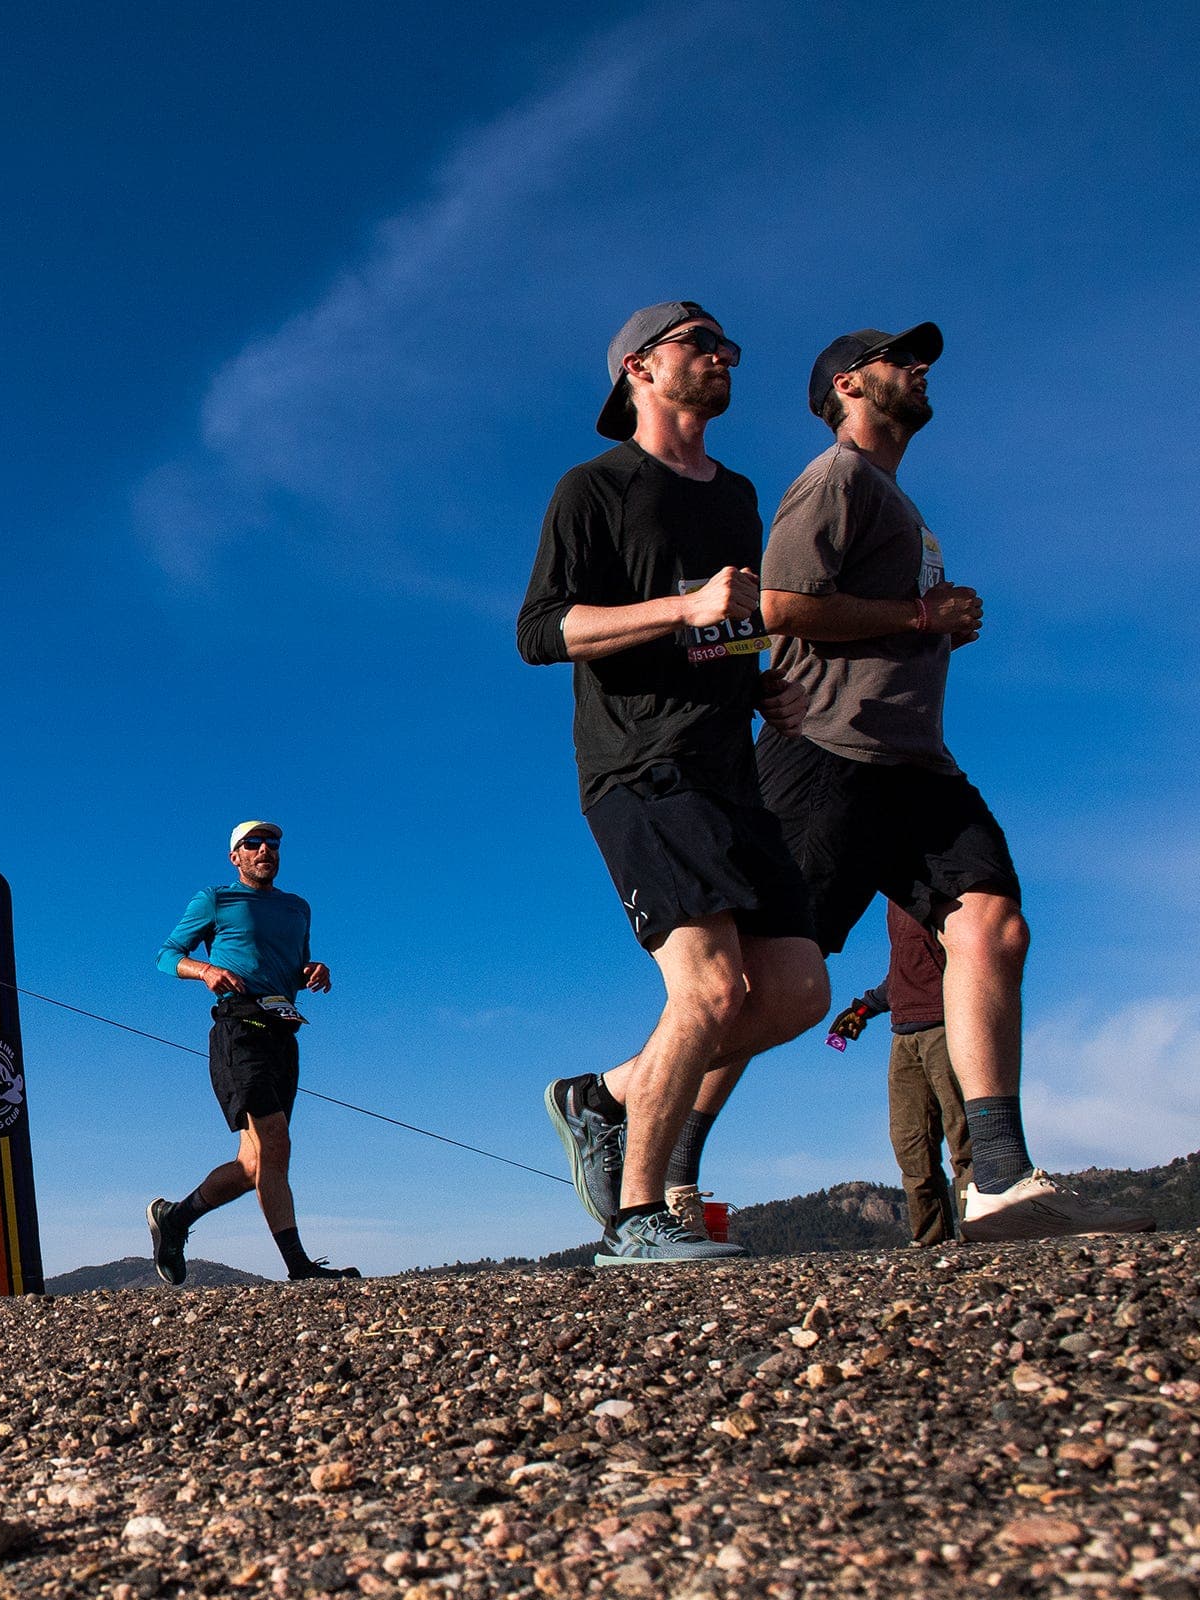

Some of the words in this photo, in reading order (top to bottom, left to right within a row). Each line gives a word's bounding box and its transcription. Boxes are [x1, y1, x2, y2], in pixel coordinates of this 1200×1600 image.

[692, 616, 754, 644] 1513
[693, 649, 715, 661] 1513
[5, 1107, 20, 1126] CLUB
